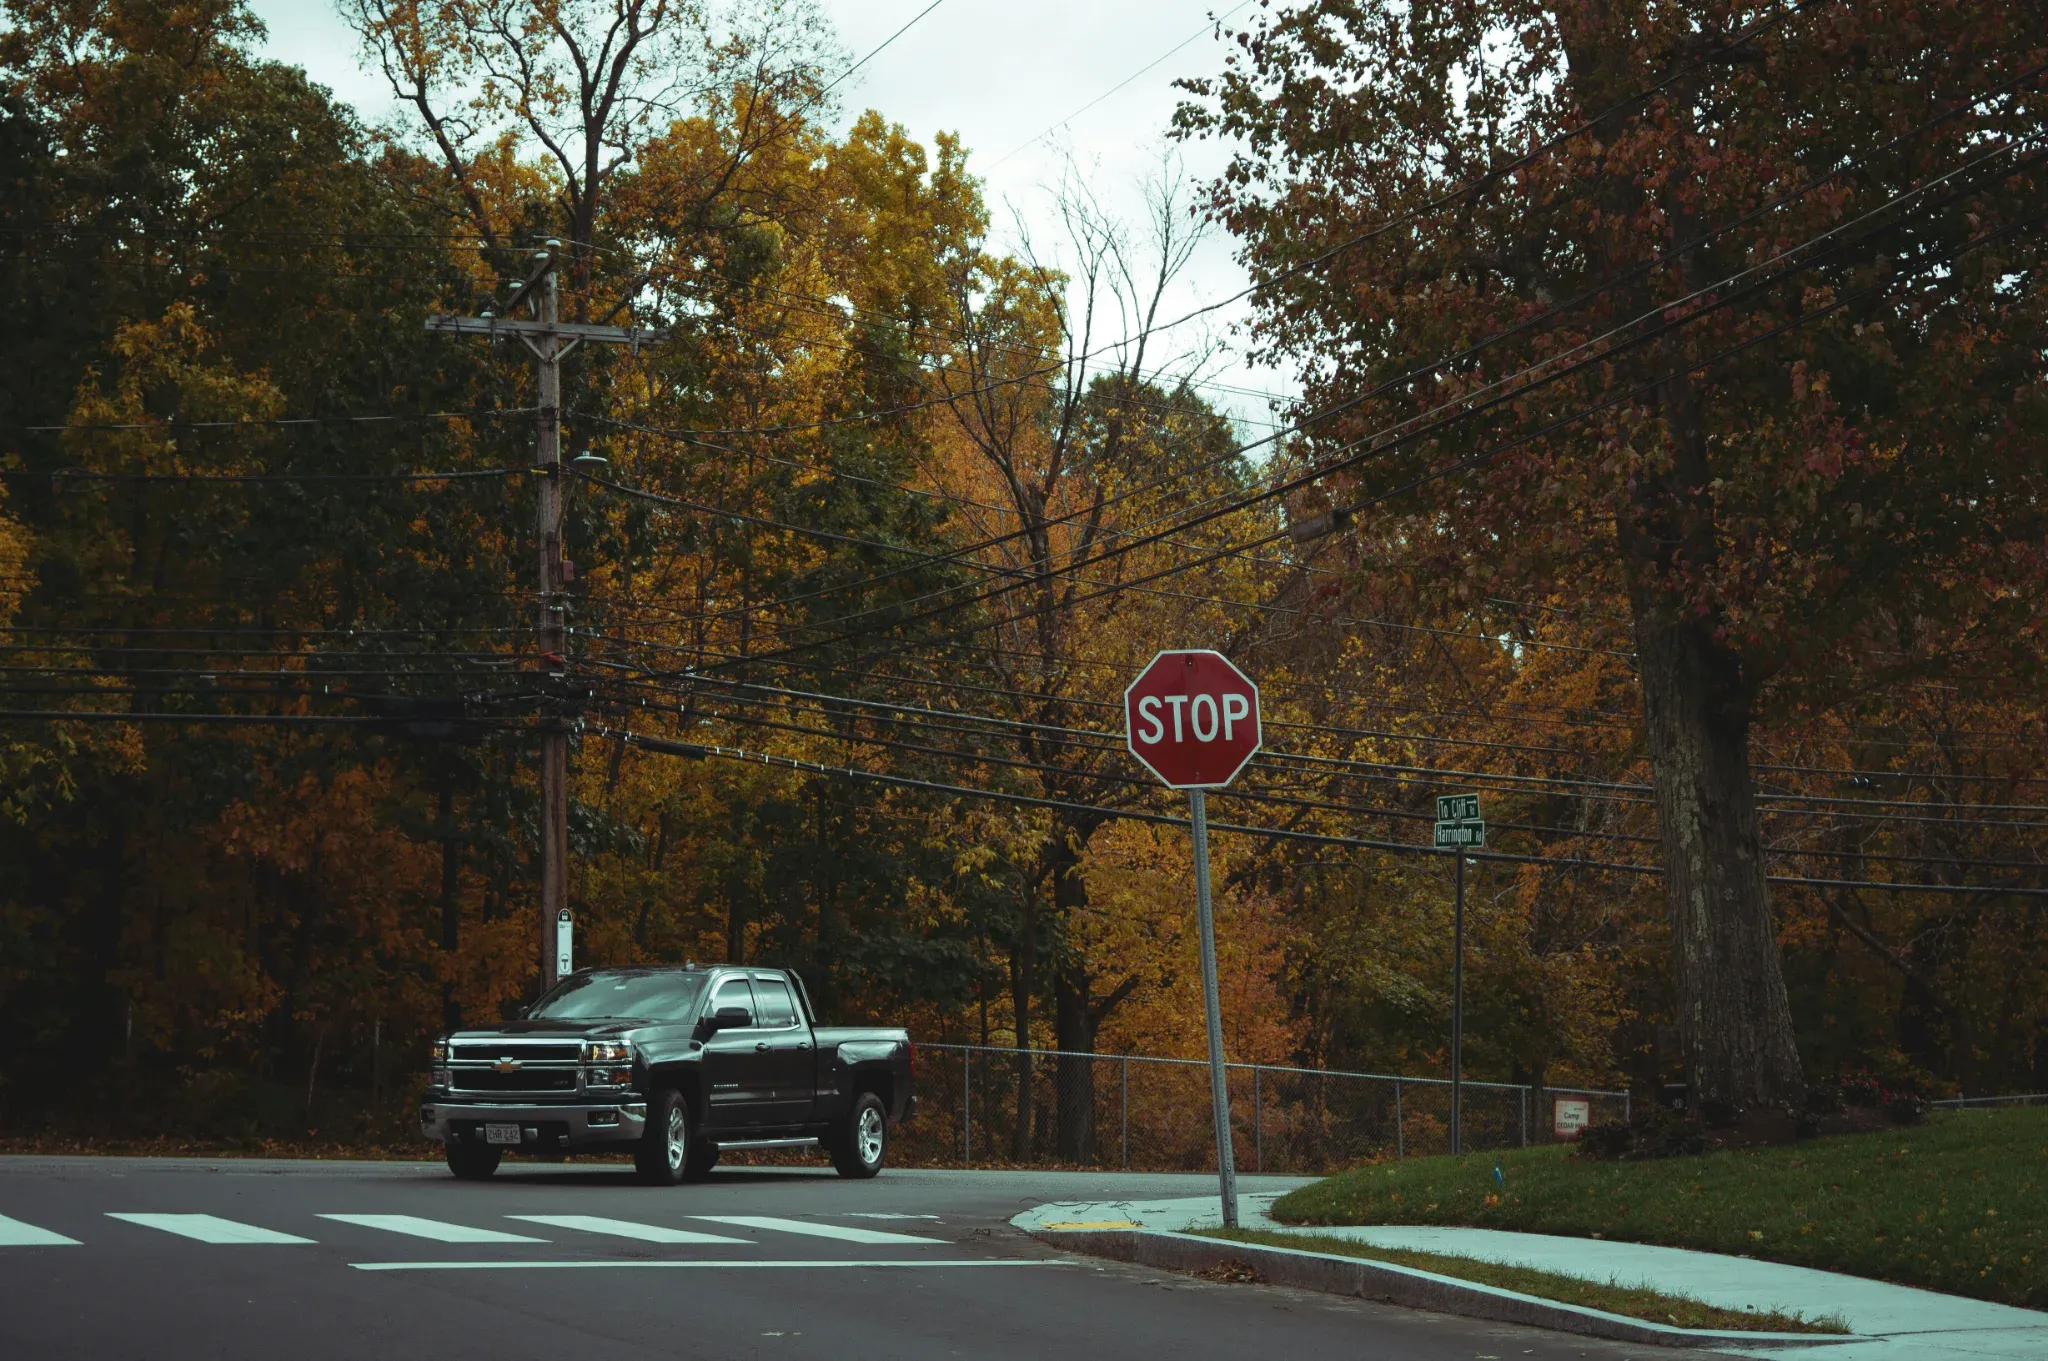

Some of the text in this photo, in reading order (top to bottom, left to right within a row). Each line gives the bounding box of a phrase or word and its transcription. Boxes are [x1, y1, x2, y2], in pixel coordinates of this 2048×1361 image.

[1138, 694, 1249, 744] STOP
[1440, 801, 1449, 818] To
[1452, 799, 1467, 817] Cliff
[1438, 825, 1472, 845] Harrington
[1564, 1112, 1580, 1120] Camp
